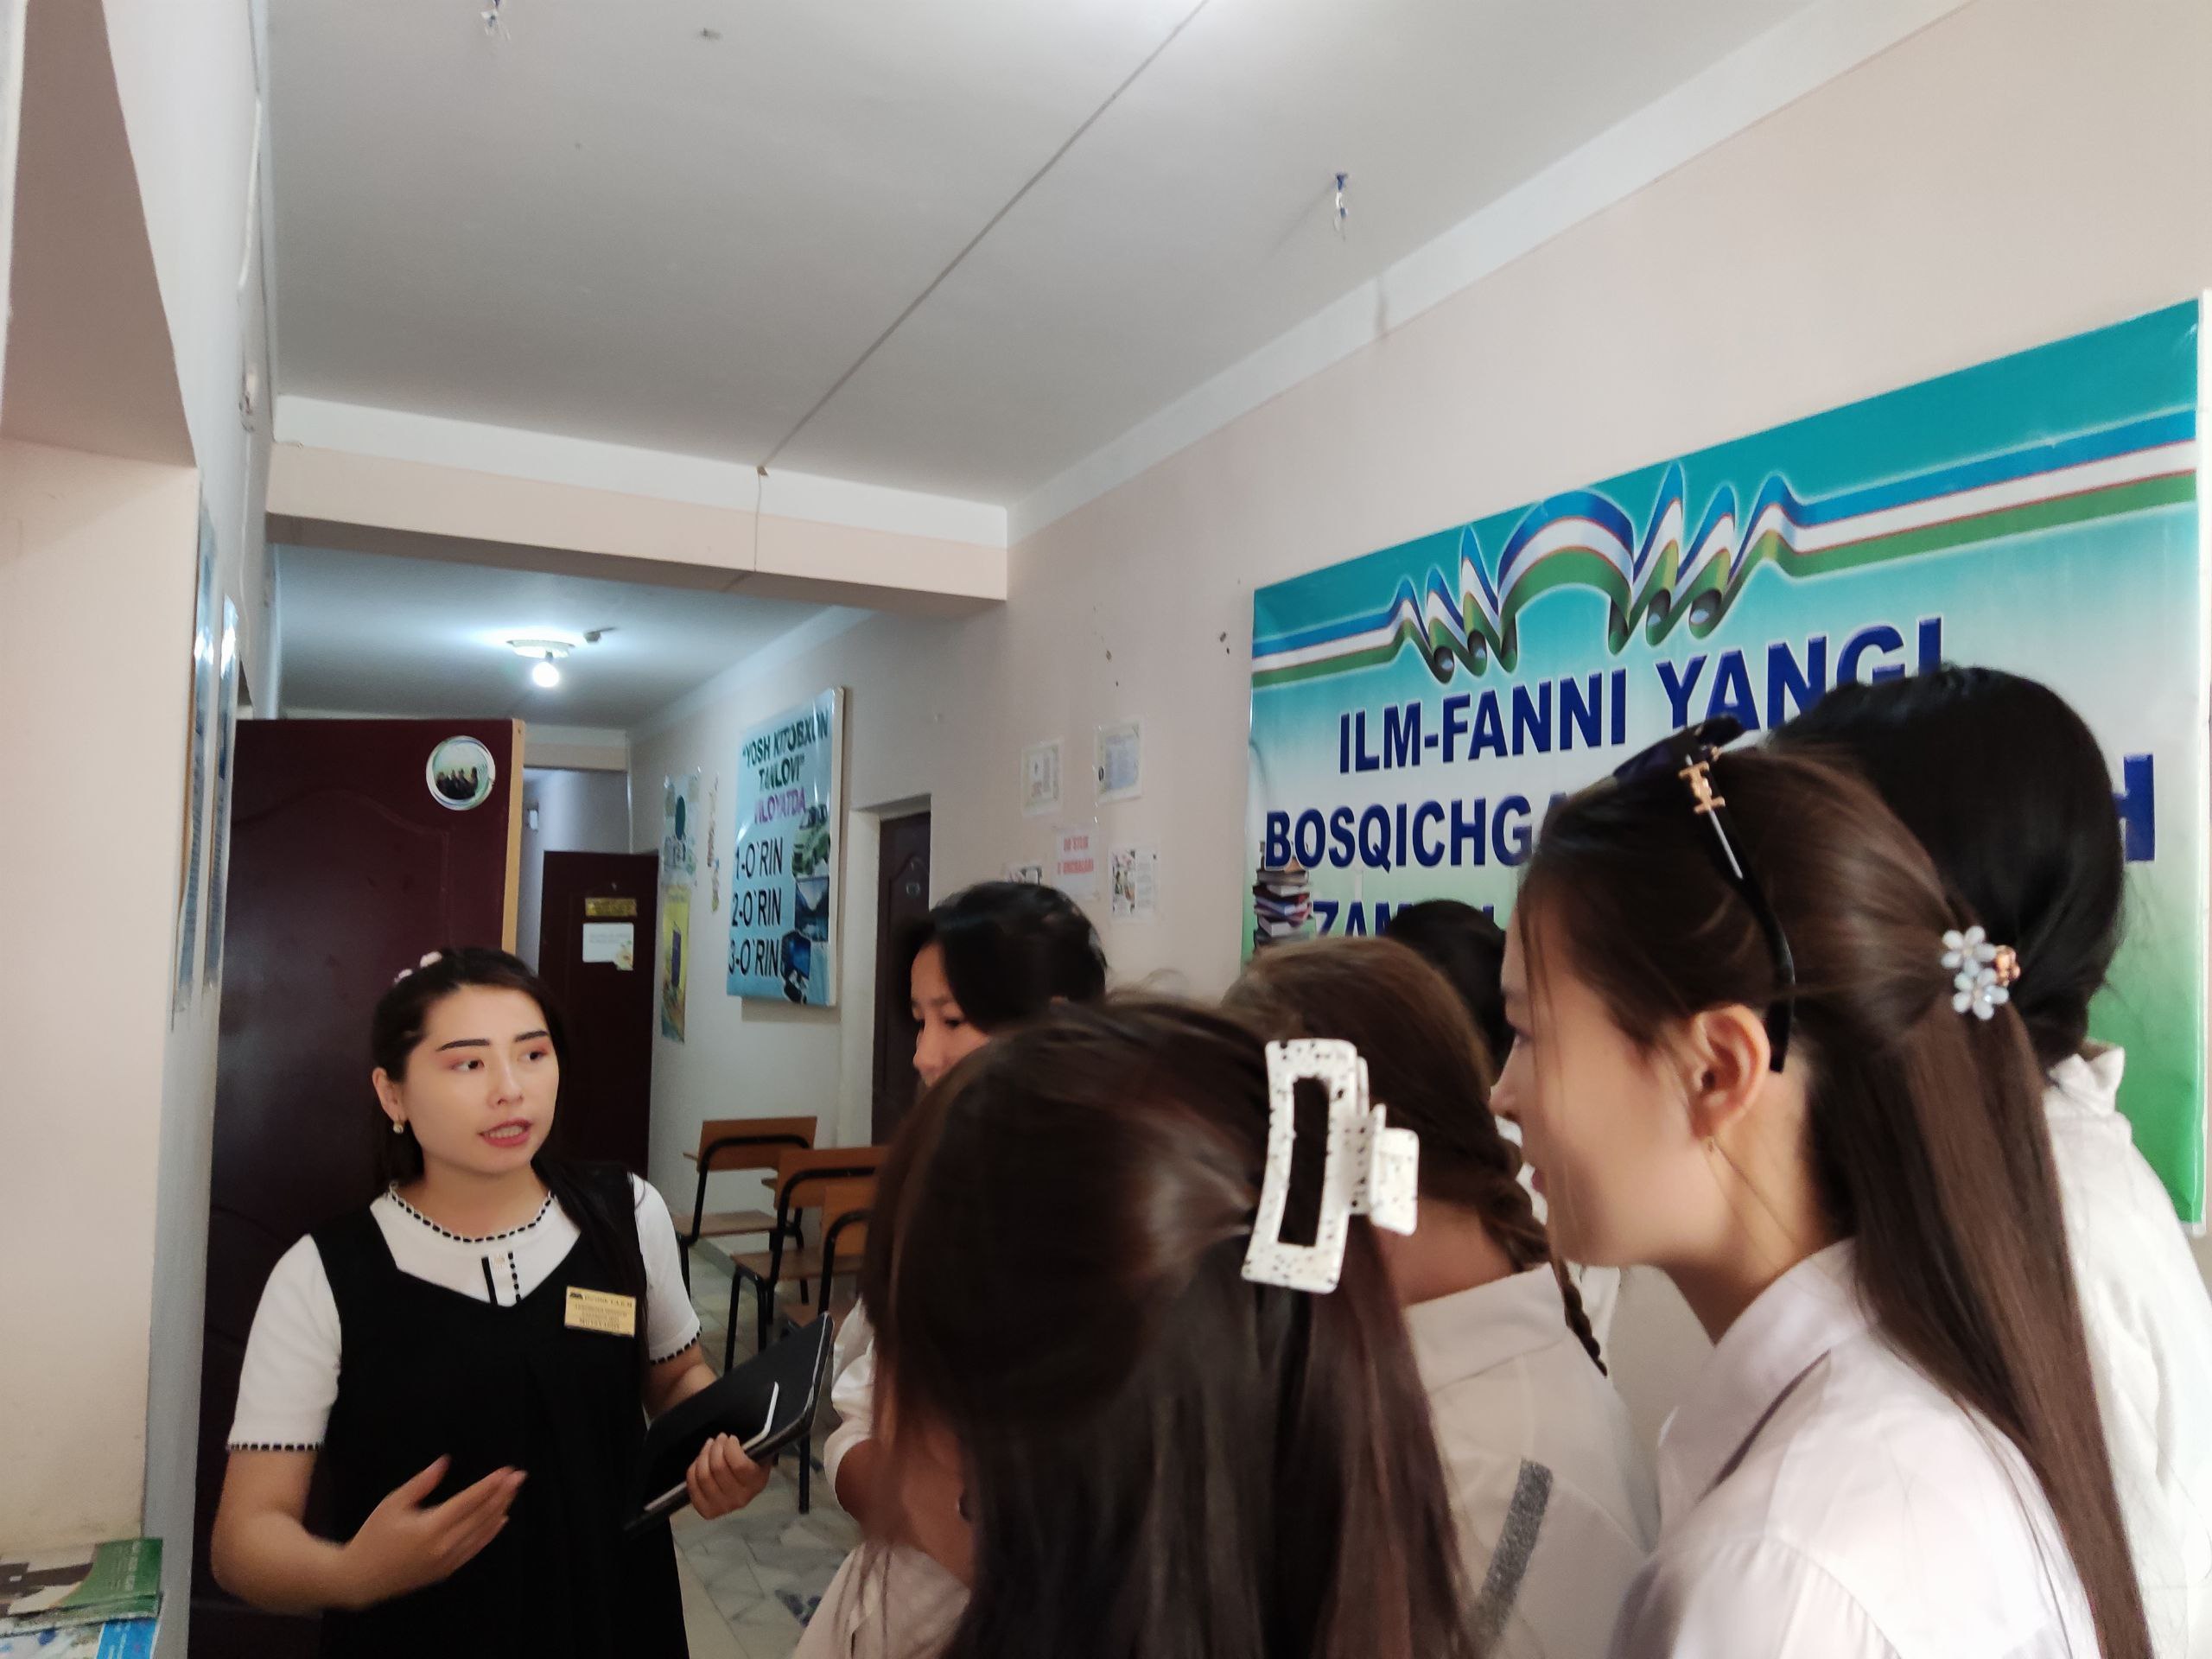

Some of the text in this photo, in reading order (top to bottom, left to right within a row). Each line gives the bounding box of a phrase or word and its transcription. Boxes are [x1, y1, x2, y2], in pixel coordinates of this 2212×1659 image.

[1339, 616, 1942, 774] ILM-FANNI YANGI
[1265, 791, 1567, 874] BOSQICHG
